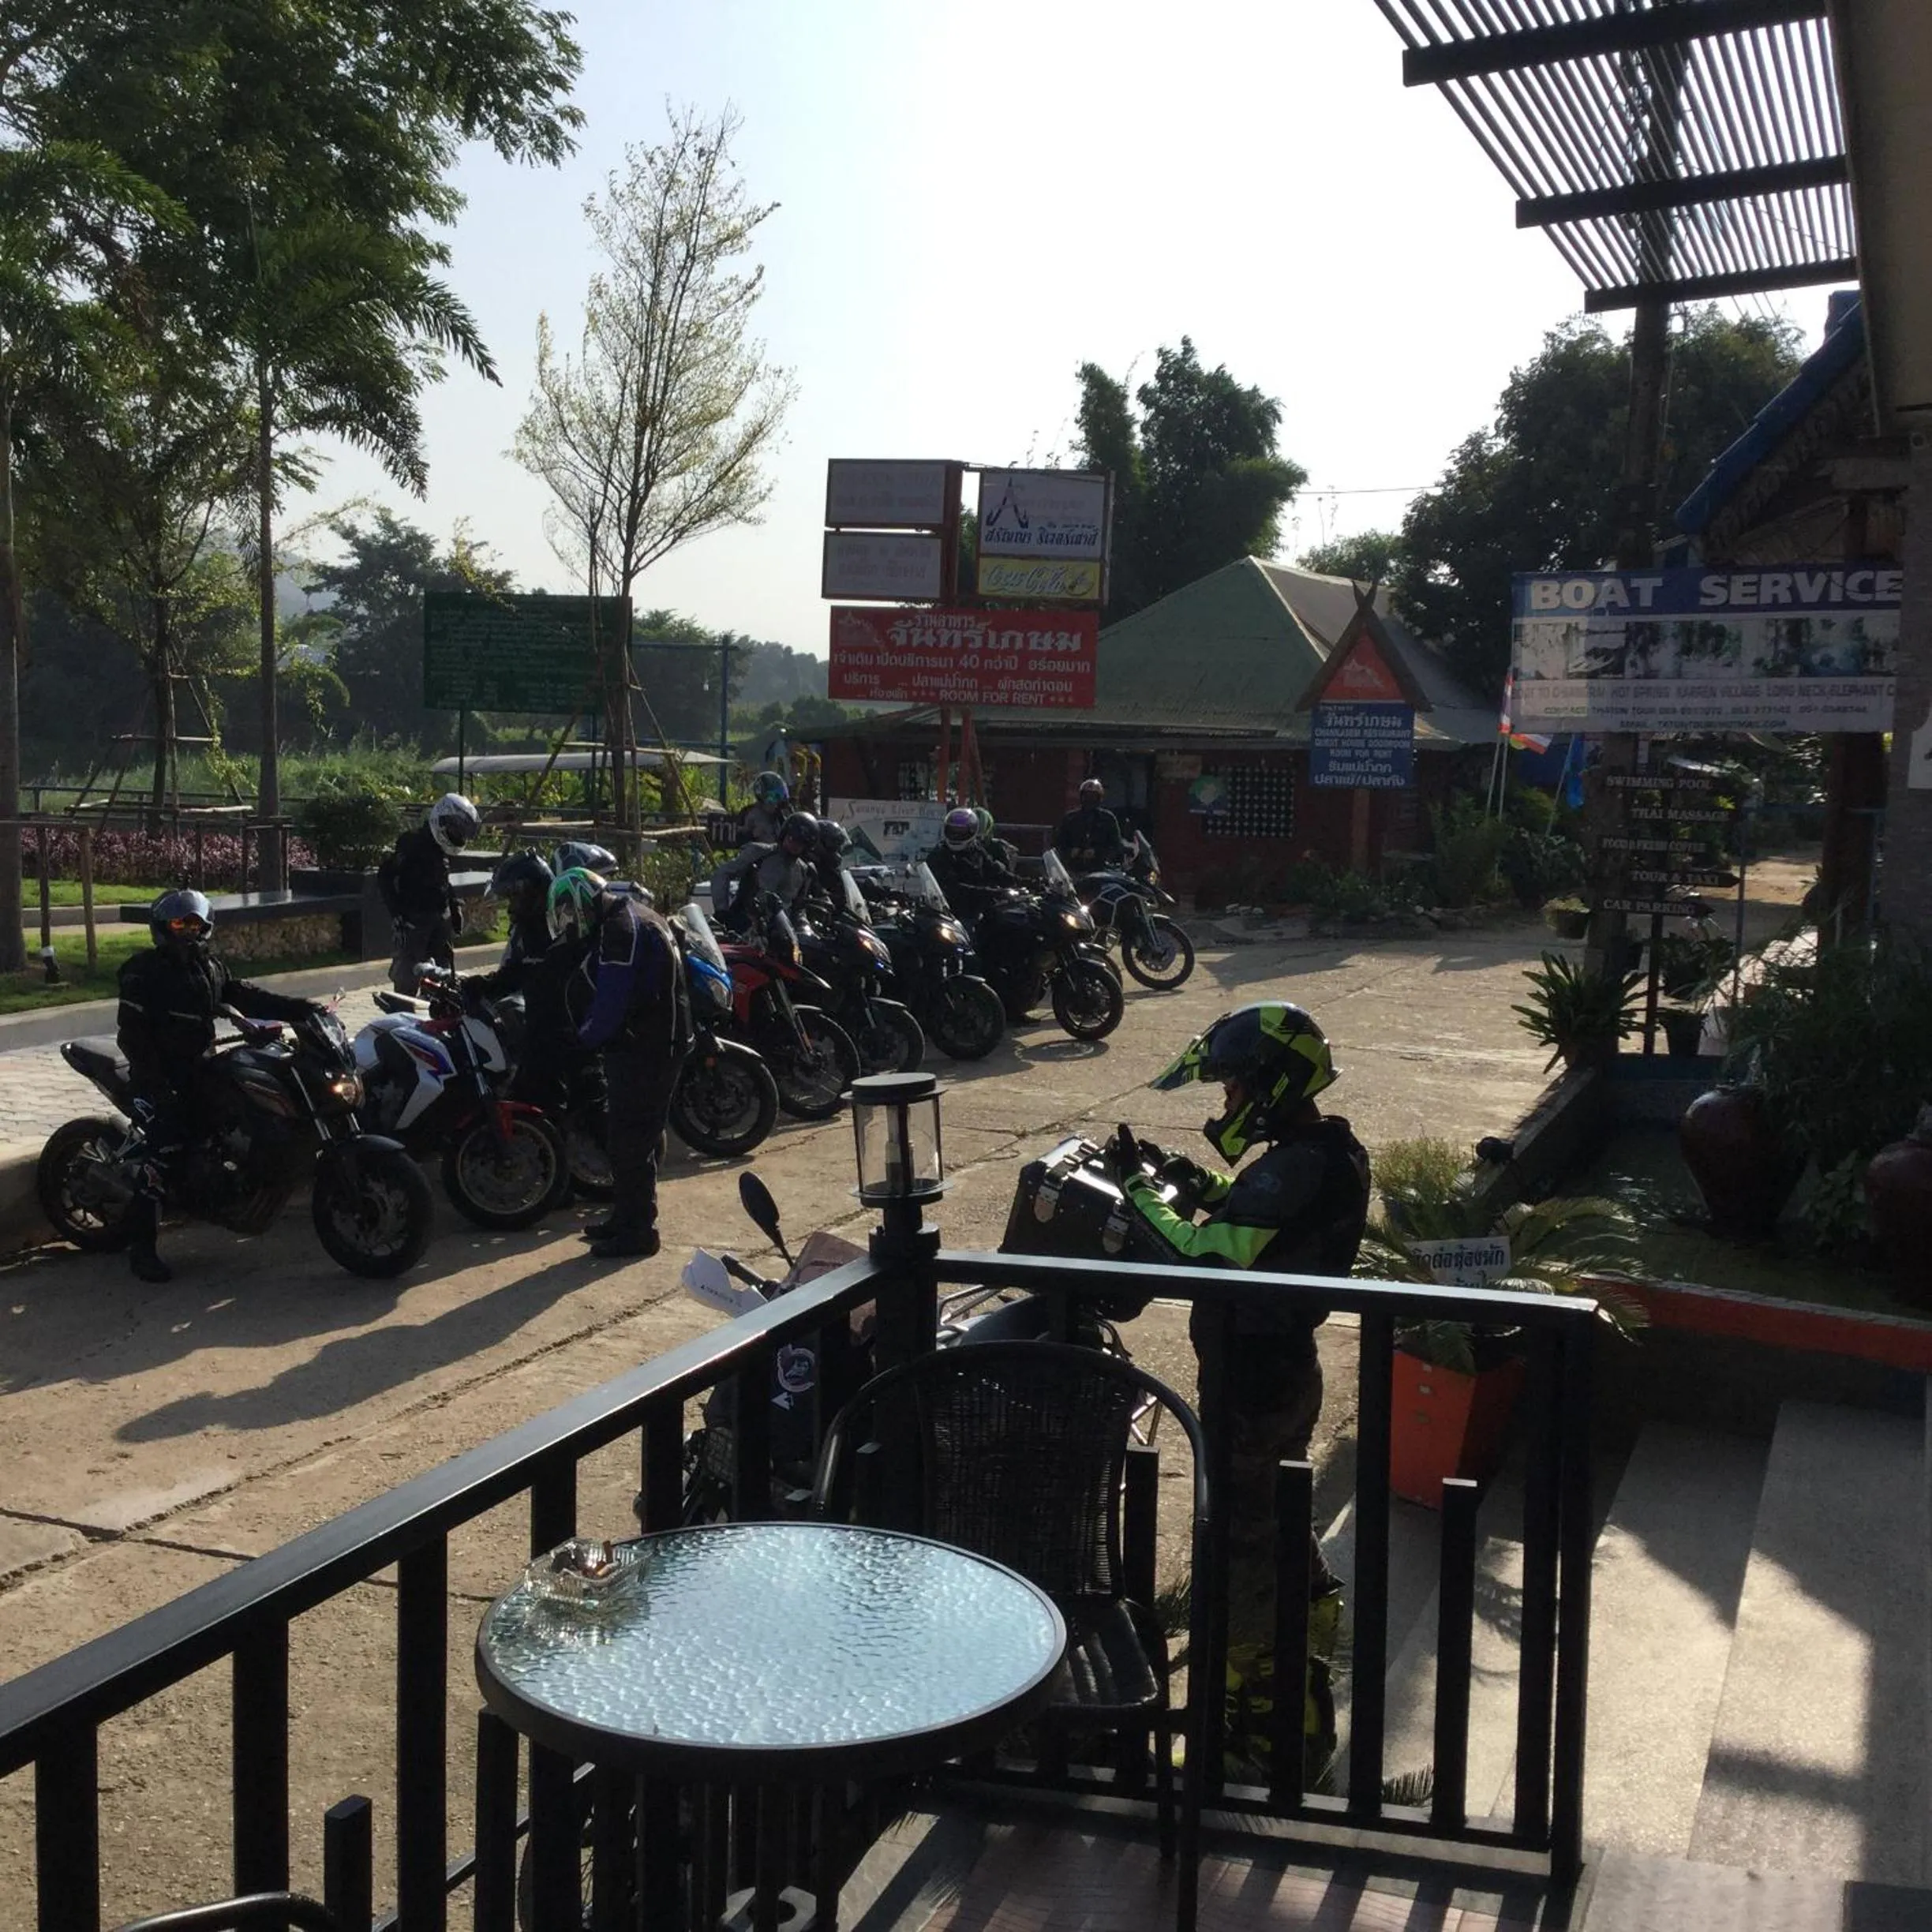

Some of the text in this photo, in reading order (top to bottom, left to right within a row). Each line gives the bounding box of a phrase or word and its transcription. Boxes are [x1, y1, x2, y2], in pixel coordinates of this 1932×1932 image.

[1531, 570, 1904, 610] BOAT SERVICE
[887, 619, 1083, 651] จันทร์เกษม
[959, 654, 979, 668] 40
[939, 690, 978, 702] ROOM
[983, 691, 1008, 703] FOR
[1013, 691, 1046, 705] RENT
[1606, 776, 1713, 789] SWIMMING POOL
[1631, 808, 1730, 822] THAI MASSAGE
[1631, 871, 1668, 882] TOUR
[1686, 874, 1720, 886] TAXI
[1604, 899, 1696, 915] CAR PARKING
